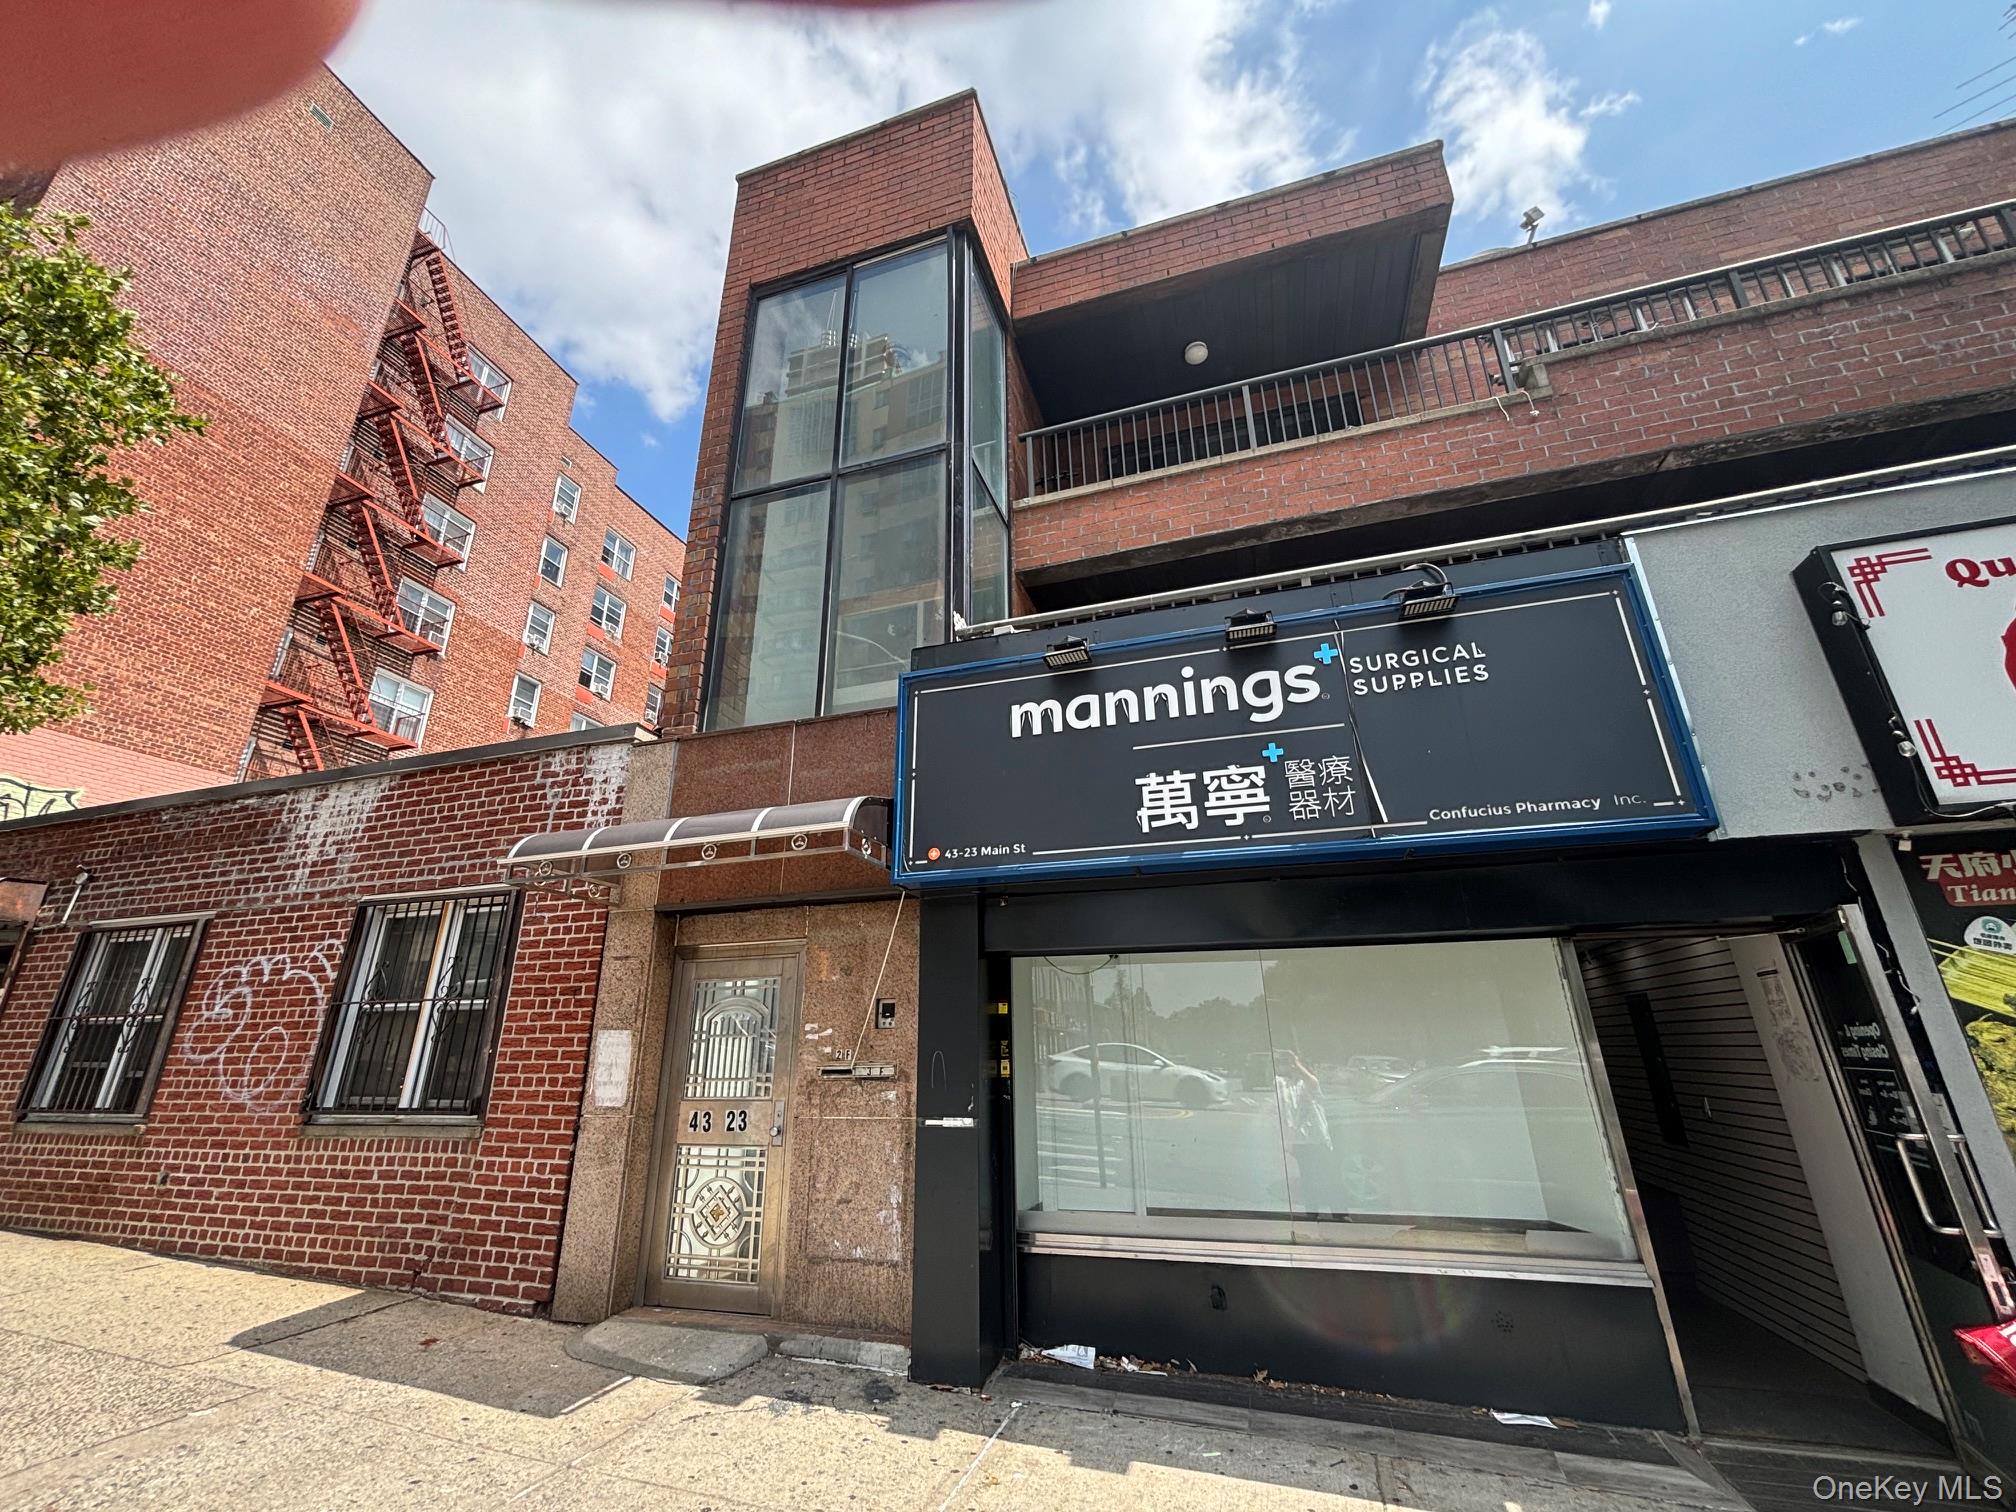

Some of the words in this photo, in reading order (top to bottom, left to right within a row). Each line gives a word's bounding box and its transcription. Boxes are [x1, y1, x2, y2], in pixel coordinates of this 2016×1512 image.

[1349, 641, 1487, 675] SURGICAL
[1353, 663, 1490, 696] SUPPLIES
[1011, 664, 1321, 739] mannings
[1284, 754, 1354, 789] 醫療
[1134, 764, 1272, 834] 萬寧
[1288, 785, 1357, 821] 器材
[1429, 802, 1511, 821] Confucius
[1515, 795, 1601, 814] Pharmacy
[1613, 792, 1647, 807] Inc.
[944, 846, 978, 860] 43-23
[980, 844, 1009, 857] Main
[1011, 842, 1026, 856] St
[688, 1110, 712, 1133] 43
[725, 1109, 748, 1133] 23
